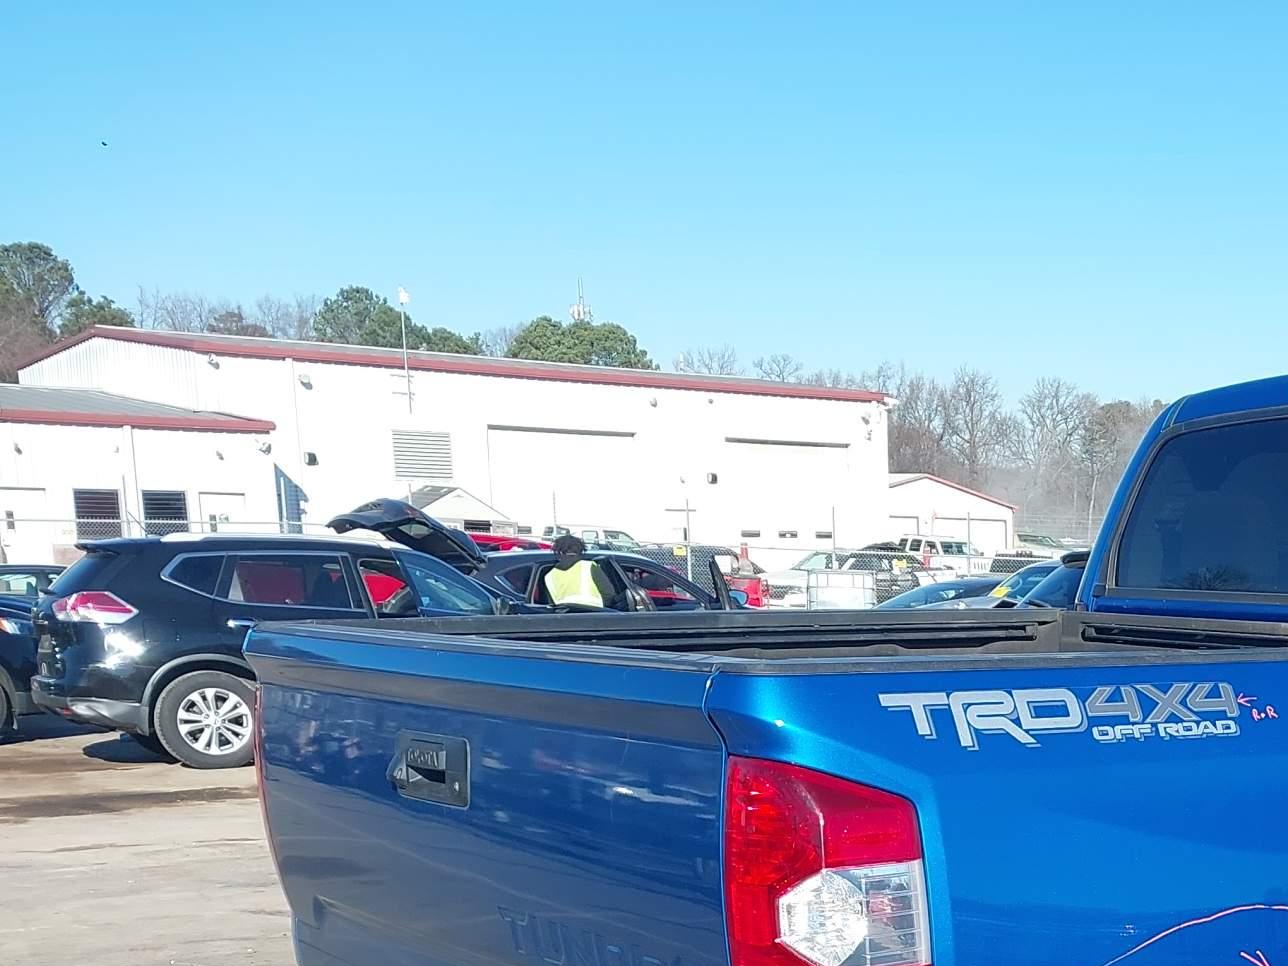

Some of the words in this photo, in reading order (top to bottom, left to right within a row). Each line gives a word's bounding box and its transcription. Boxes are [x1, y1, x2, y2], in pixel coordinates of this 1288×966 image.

[879, 689, 1087, 750] TRD
[1086, 682, 1240, 723] 4X4
[1092, 723, 1153, 744] OFF
[1159, 719, 1240, 741] ROAD
